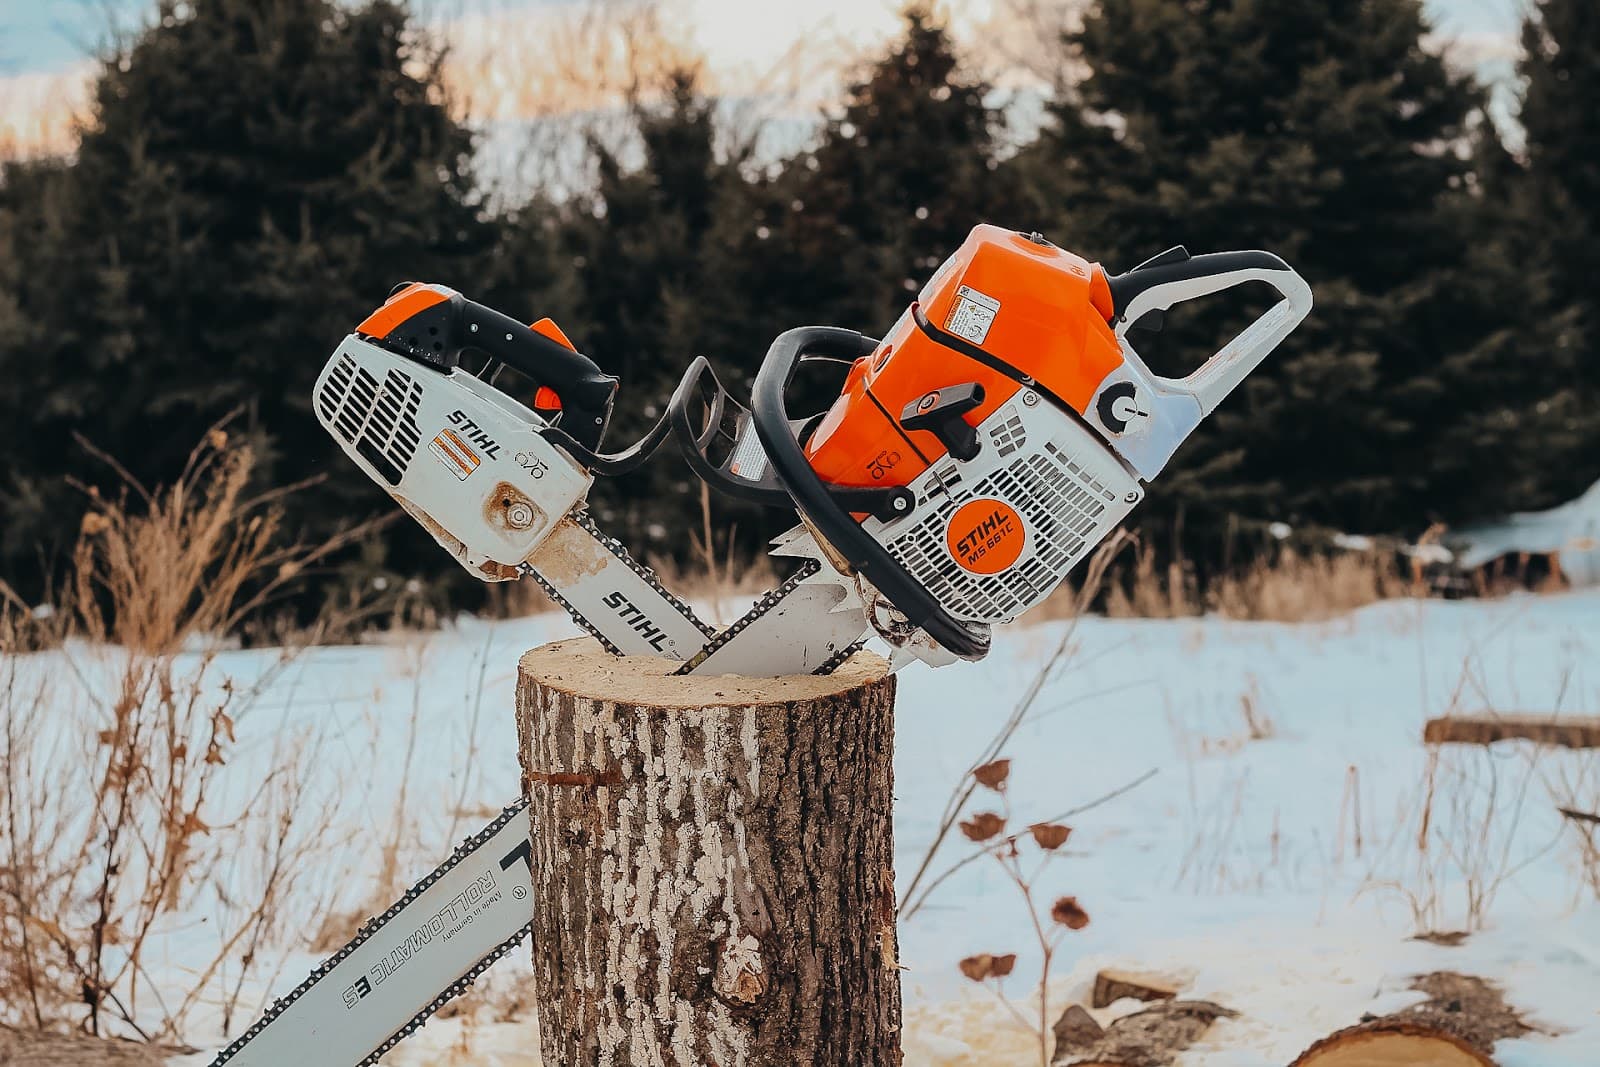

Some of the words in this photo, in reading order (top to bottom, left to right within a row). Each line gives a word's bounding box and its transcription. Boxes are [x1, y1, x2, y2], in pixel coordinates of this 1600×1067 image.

[446, 410, 500, 461] STIHL
[957, 510, 1009, 558] STIHL
[967, 546, 987, 565] MS
[987, 522, 1014, 549] 661C
[602, 591, 668, 652] STIHL
[473, 907, 481, 916] in
[482, 890, 502, 910] Made
[370, 870, 497, 985] ROLLOMATIC
[442, 915, 474, 942] Germany
[342, 975, 372, 1009] ES
